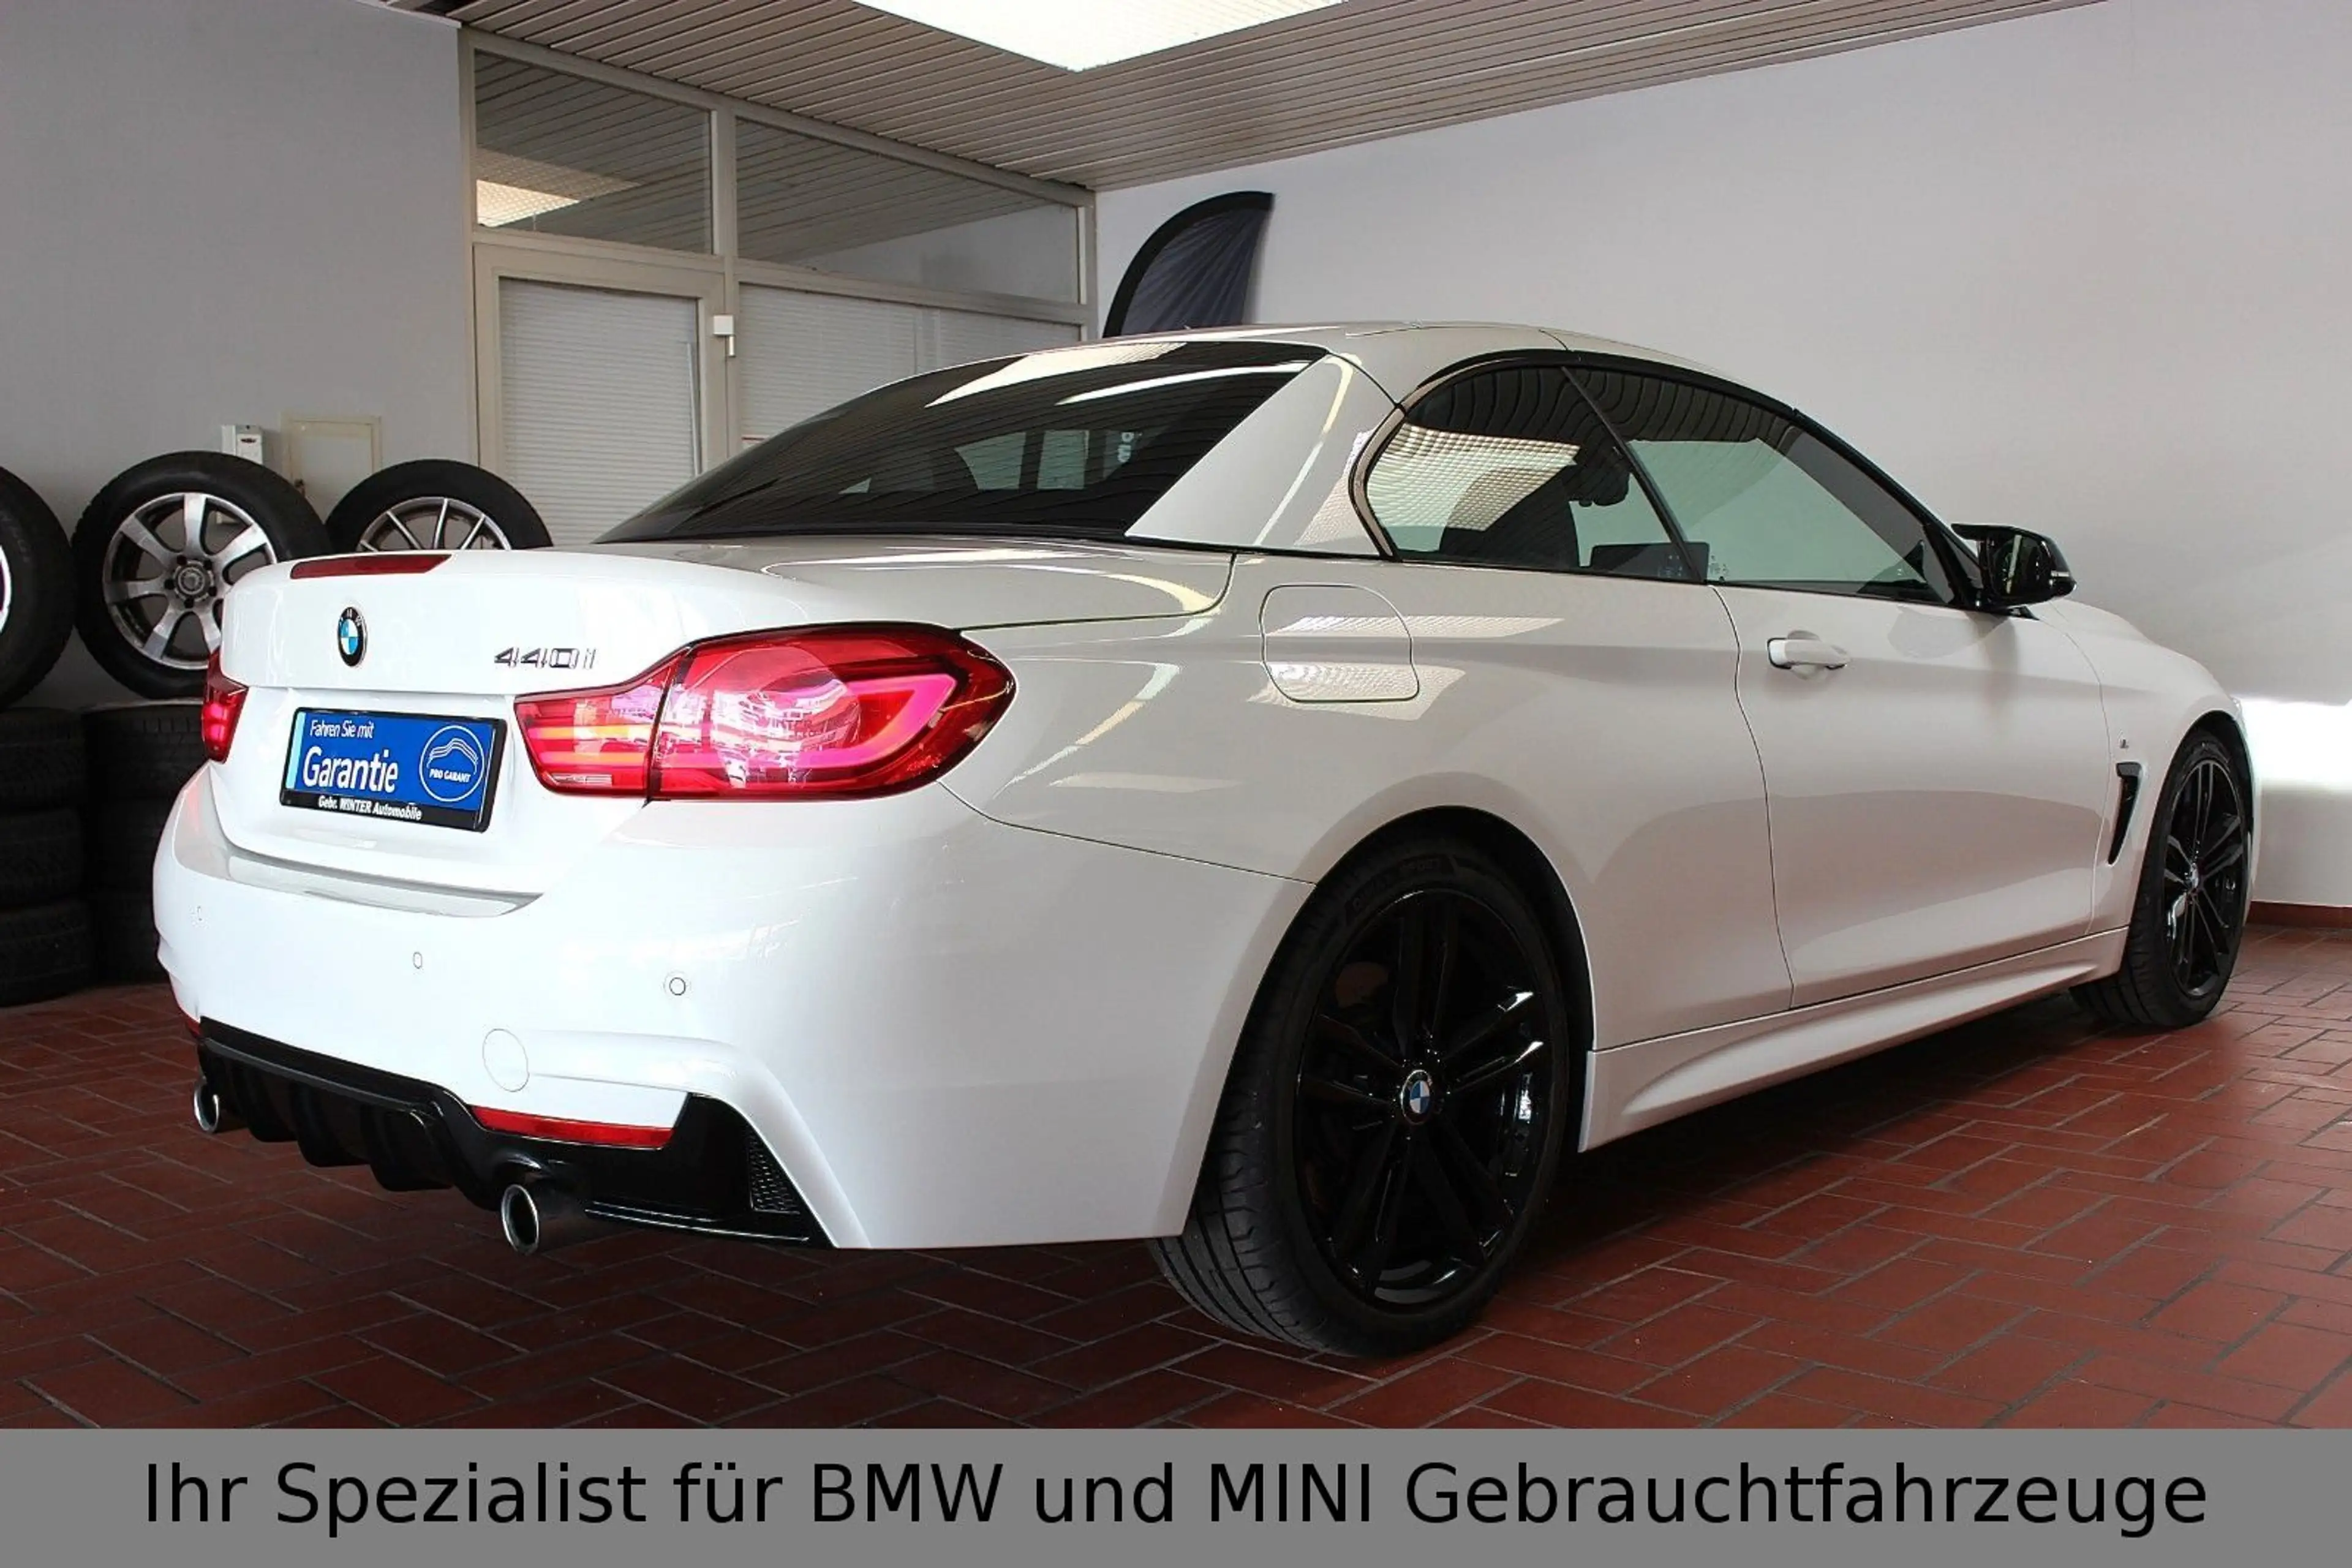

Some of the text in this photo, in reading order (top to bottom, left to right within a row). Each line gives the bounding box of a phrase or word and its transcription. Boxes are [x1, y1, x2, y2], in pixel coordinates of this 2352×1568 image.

[494, 647, 597, 670] 440i
[310, 720, 374, 739] Fahren Sie mit
[303, 745, 398, 793] Garantie
[429, 768, 471, 783] PRO GARANT
[318, 796, 423, 821] Gebr. WINTER Automobile
